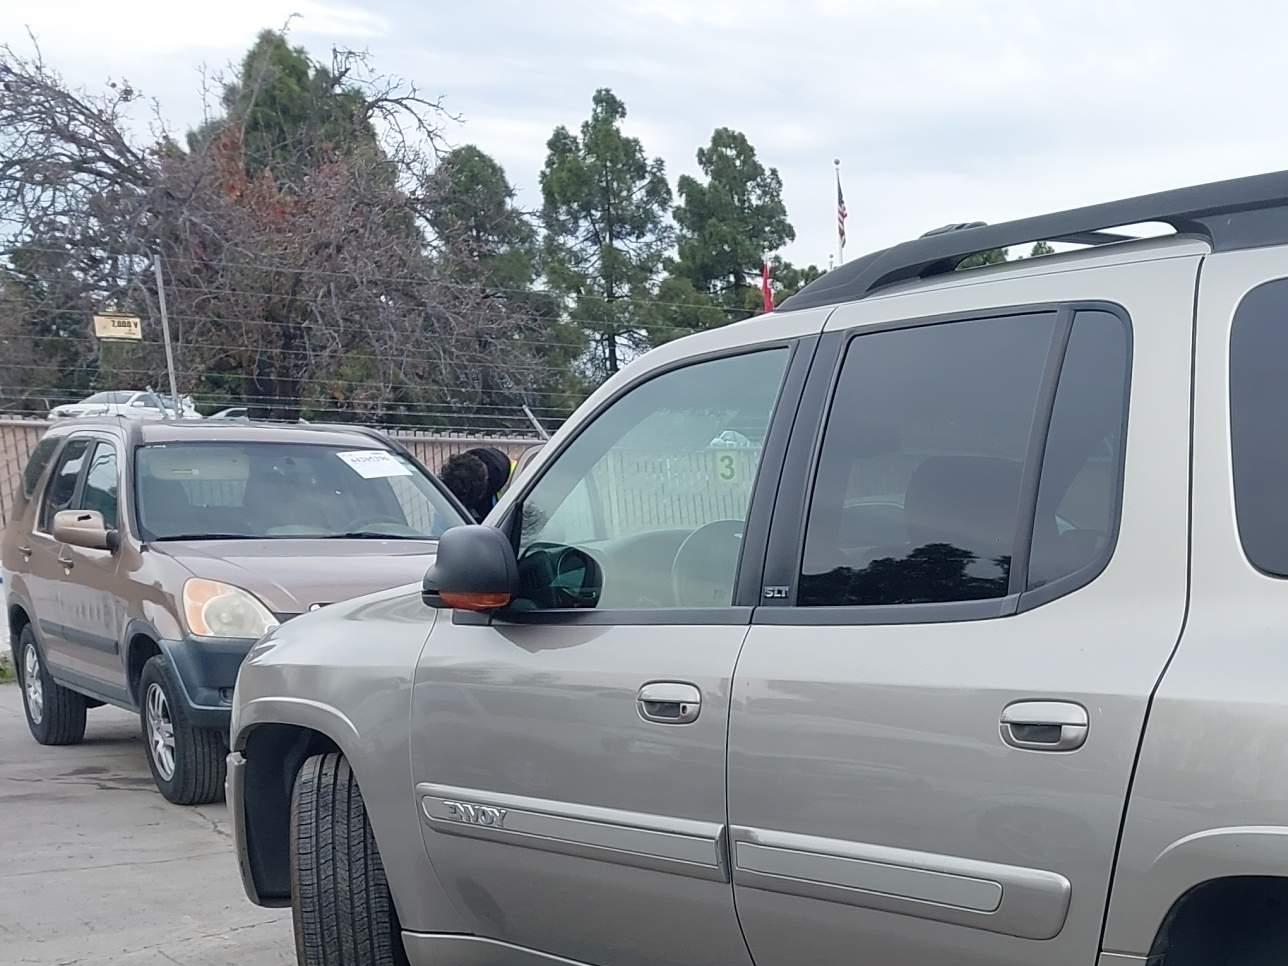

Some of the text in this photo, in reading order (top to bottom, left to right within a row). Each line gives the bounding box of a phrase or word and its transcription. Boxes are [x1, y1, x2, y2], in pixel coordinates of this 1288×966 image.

[719, 455, 735, 480] 3
[764, 586, 789, 598] SLT
[443, 801, 507, 828] ENVOY
